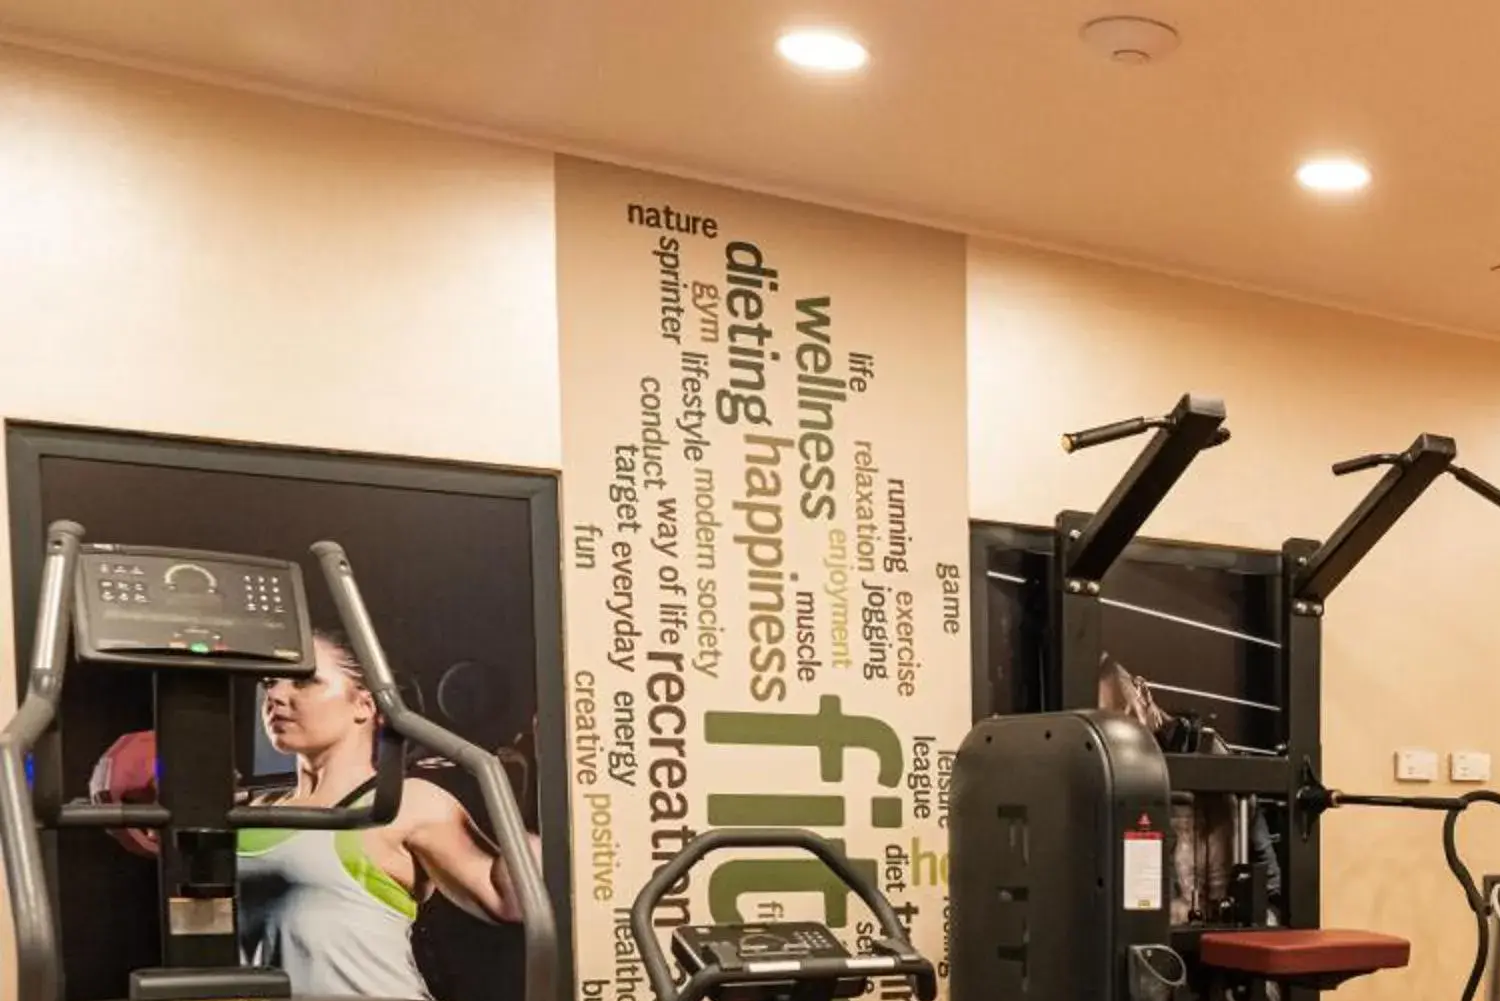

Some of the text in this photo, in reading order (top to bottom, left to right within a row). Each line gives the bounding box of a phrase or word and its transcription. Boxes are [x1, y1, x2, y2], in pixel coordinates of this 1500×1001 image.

[628, 203, 718, 239] nature
[652, 236, 686, 344] sprinter
[692, 281, 721, 342] gym
[716, 241, 779, 426] dieting
[677, 351, 709, 461] lifestyle
[795, 297, 846, 520] wellness
[848, 352, 874, 393] life
[640, 376, 668, 489] conduct
[609, 445, 644, 533] target
[854, 441, 879, 571] relaxation
[883, 478, 912, 573] running
[574, 525, 602, 569] fun
[651, 498, 688, 645] way of life
[693, 468, 725, 678] modern society
[733, 433, 799, 701] happiness
[823, 528, 853, 668] enjoyment
[937, 563, 963, 634] game
[606, 541, 641, 672] everyday
[796, 590, 822, 682] muscle
[861, 581, 893, 680] jogging
[895, 590, 921, 697] exercise
[575, 671, 601, 785] creative
[609, 691, 639, 786] energy
[909, 736, 936, 819] league
[587, 794, 621, 900] positive
[885, 844, 908, 892] diet
[857, 922, 878, 994] see
